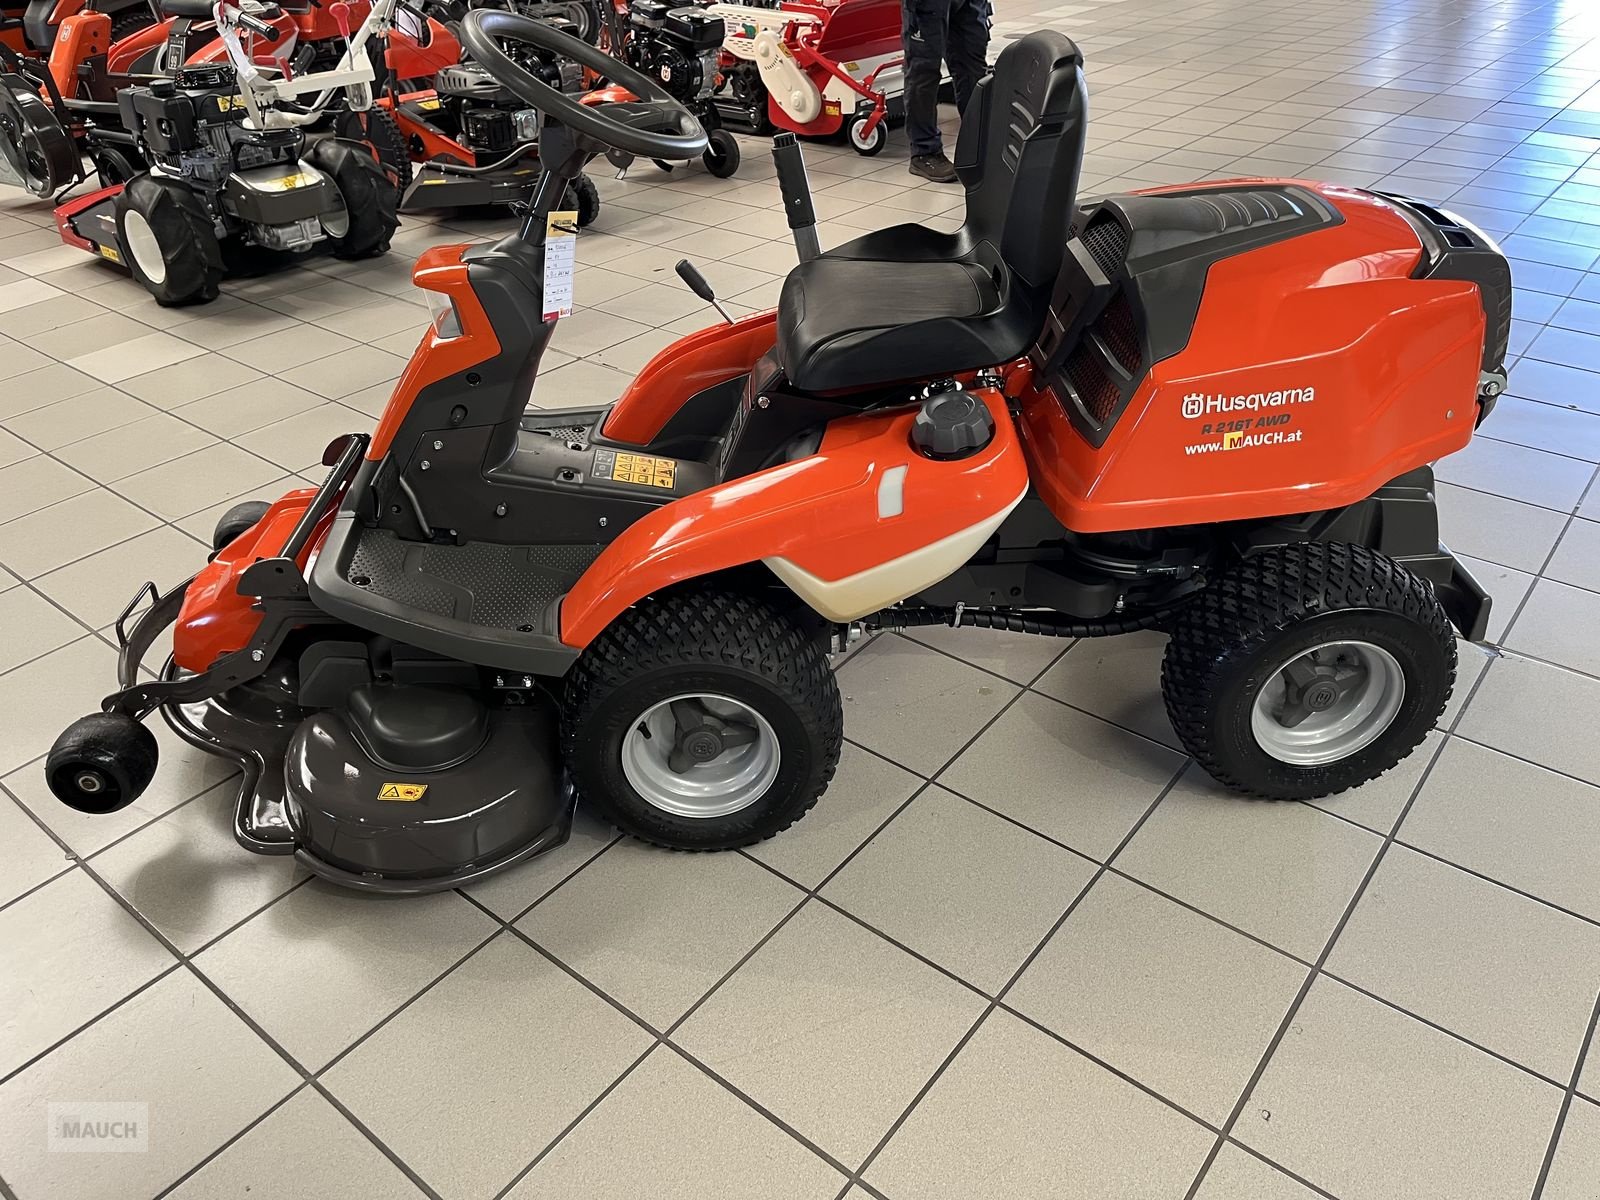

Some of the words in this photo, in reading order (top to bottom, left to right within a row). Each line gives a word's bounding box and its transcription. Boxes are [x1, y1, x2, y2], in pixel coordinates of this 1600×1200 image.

[1206, 386, 1315, 413] Husqvarna
[1201, 424, 1211, 434] R
[1216, 418, 1253, 433] 216T
[1255, 413, 1291, 428] AWD
[1185, 430, 1302, 455] www.MAUCH.at
